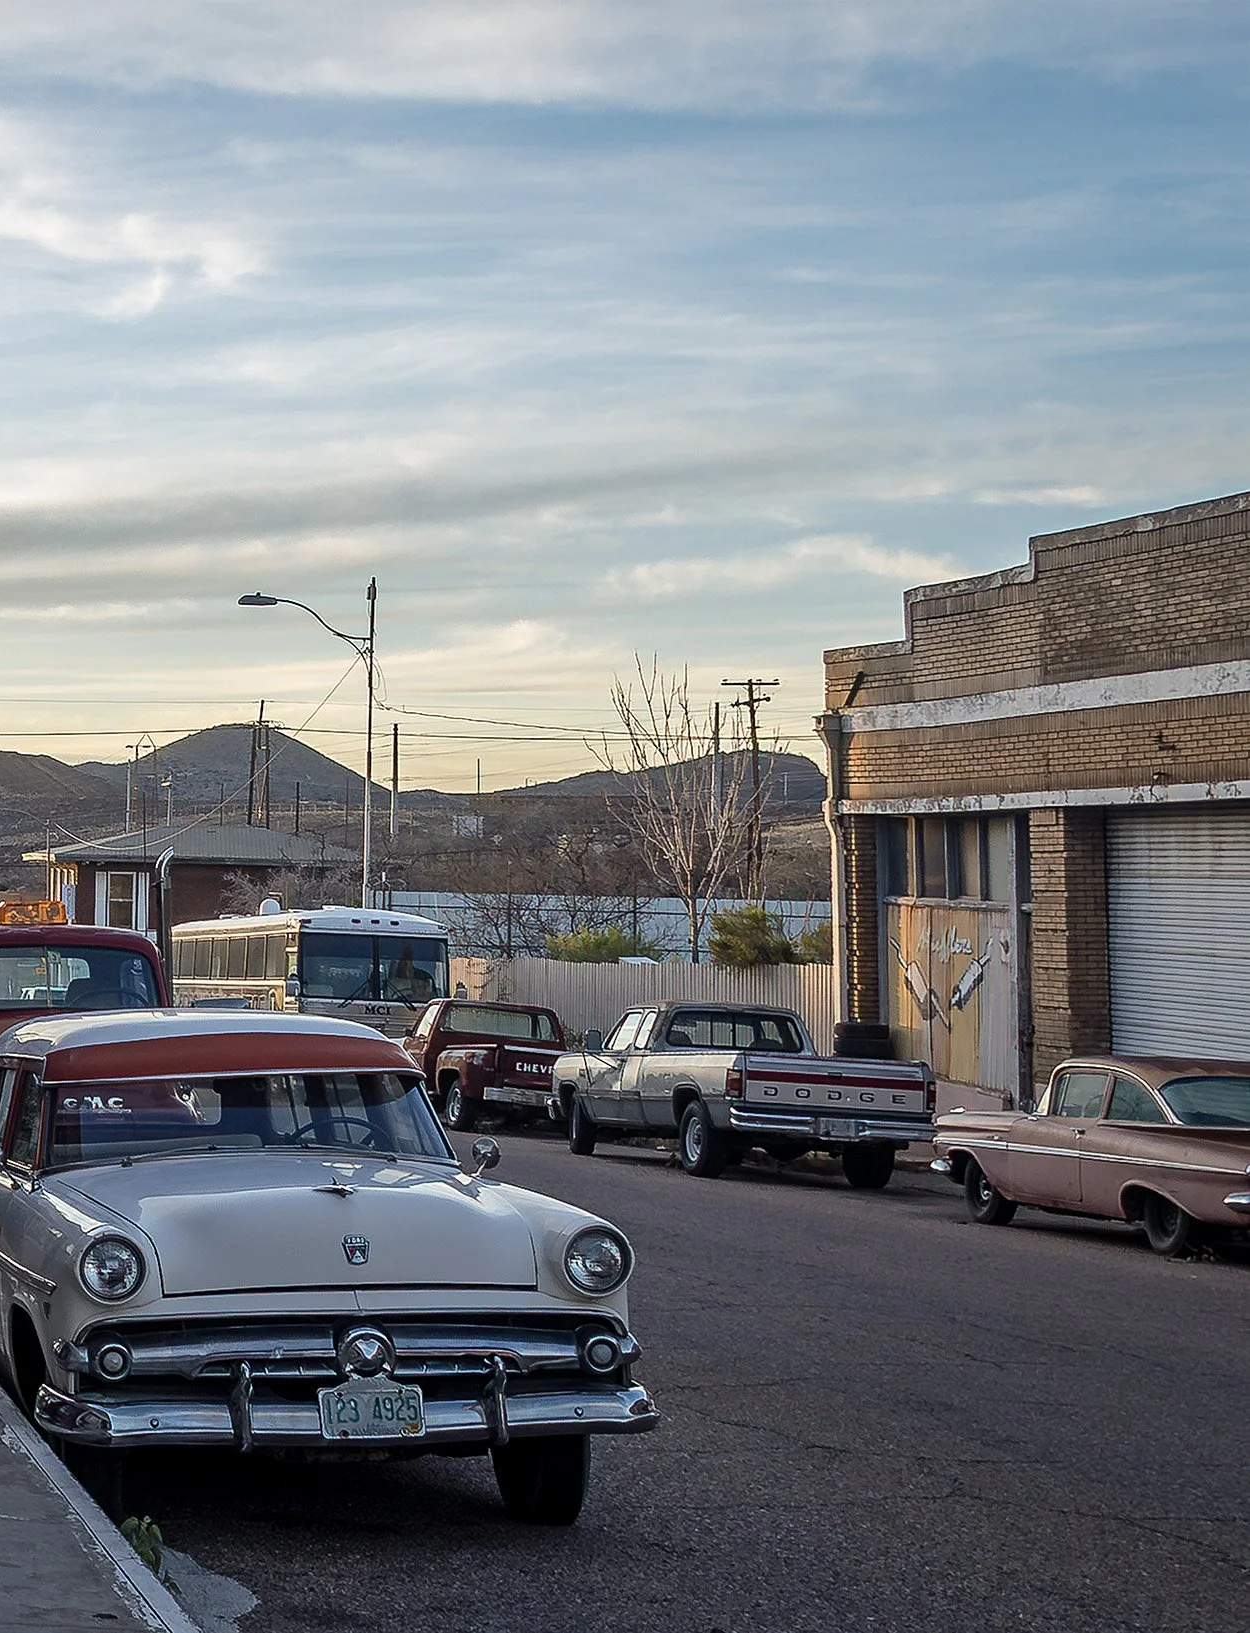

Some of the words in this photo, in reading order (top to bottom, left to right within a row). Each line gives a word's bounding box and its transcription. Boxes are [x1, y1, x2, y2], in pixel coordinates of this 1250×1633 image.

[365, 1004, 391, 1015] MCI
[63, 1096, 124, 1108] GMC
[763, 1086, 906, 1104] DODGE
[327, 1397, 360, 1424] 123
